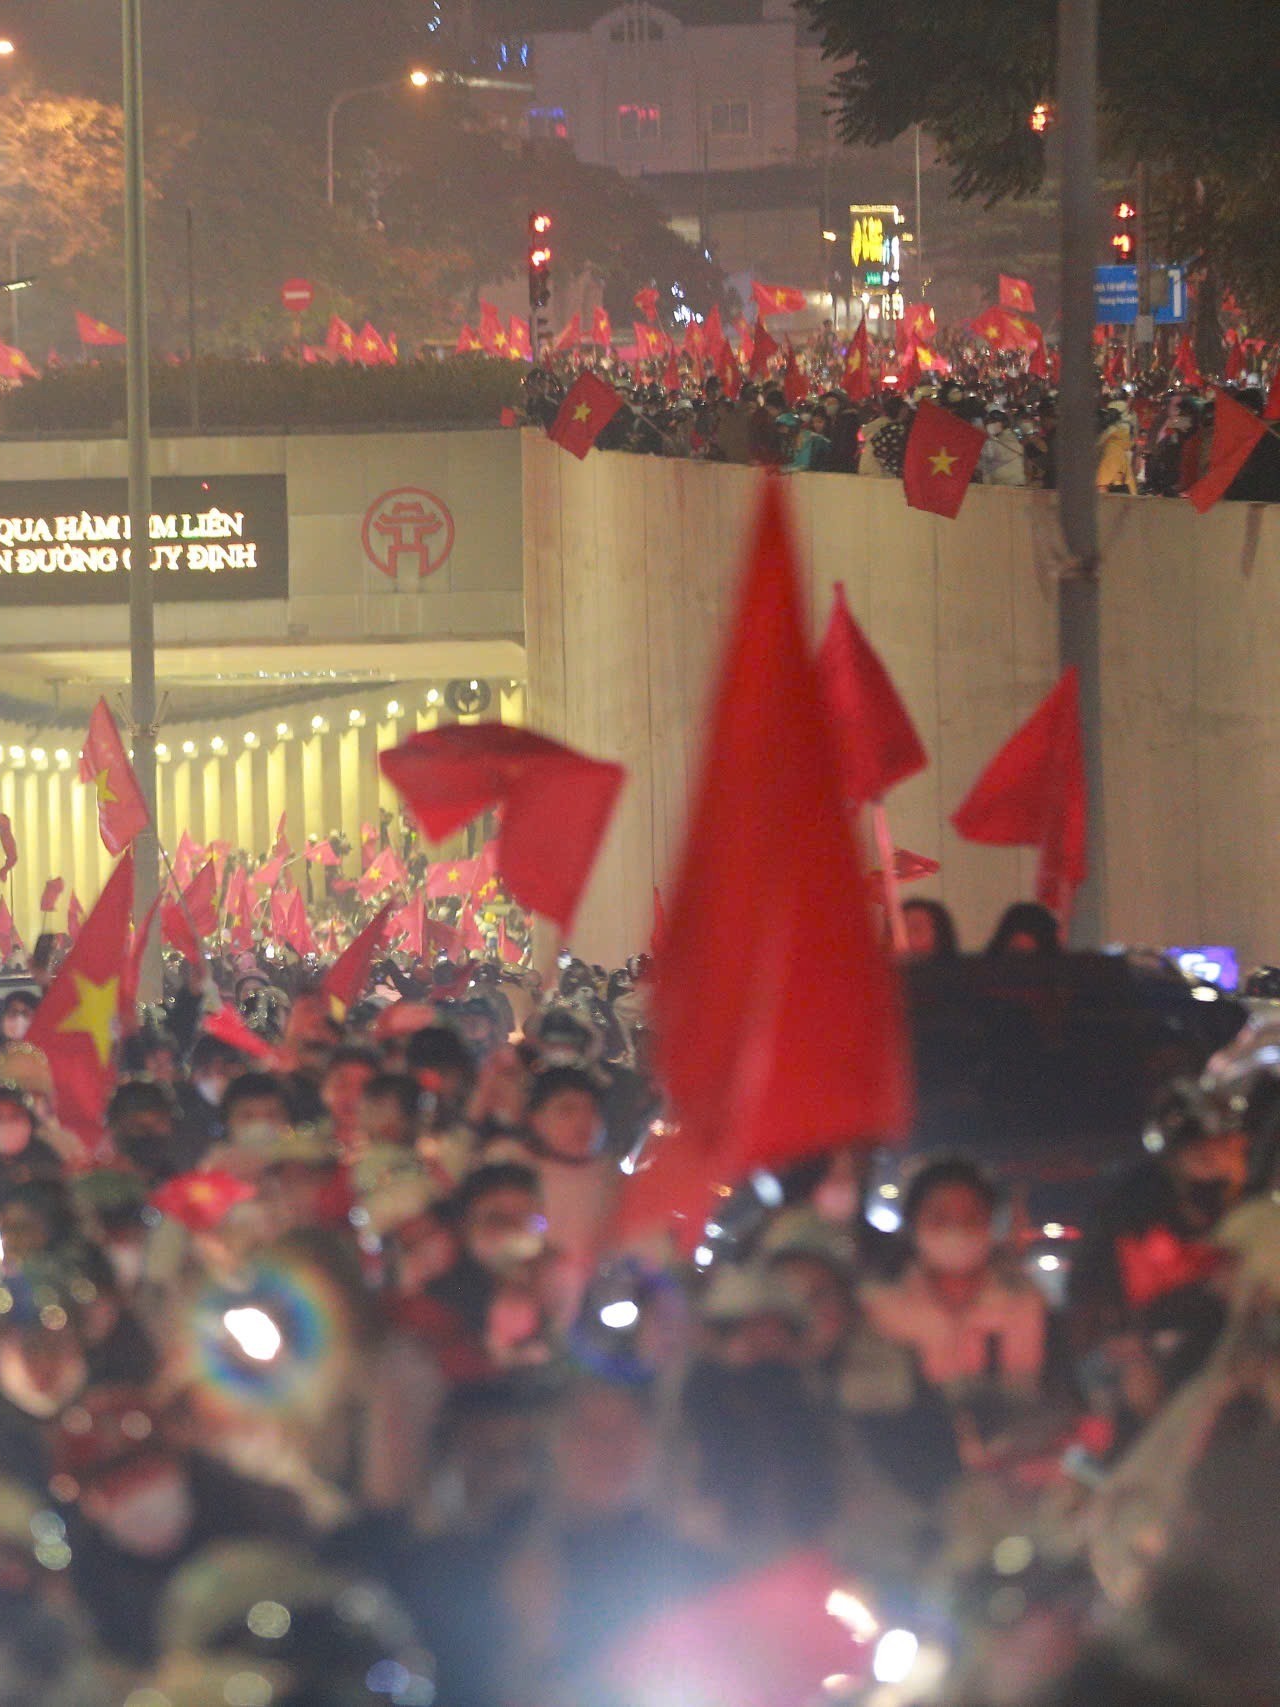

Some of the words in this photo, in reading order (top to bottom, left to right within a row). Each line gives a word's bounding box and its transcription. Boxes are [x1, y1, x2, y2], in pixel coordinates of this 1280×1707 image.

[54, 510, 121, 541] HÀM
[181, 507, 244, 538] LIÊN
[15, 543, 118, 574] ĐƯỜNG
[186, 542, 257, 573] ĐỊNH
